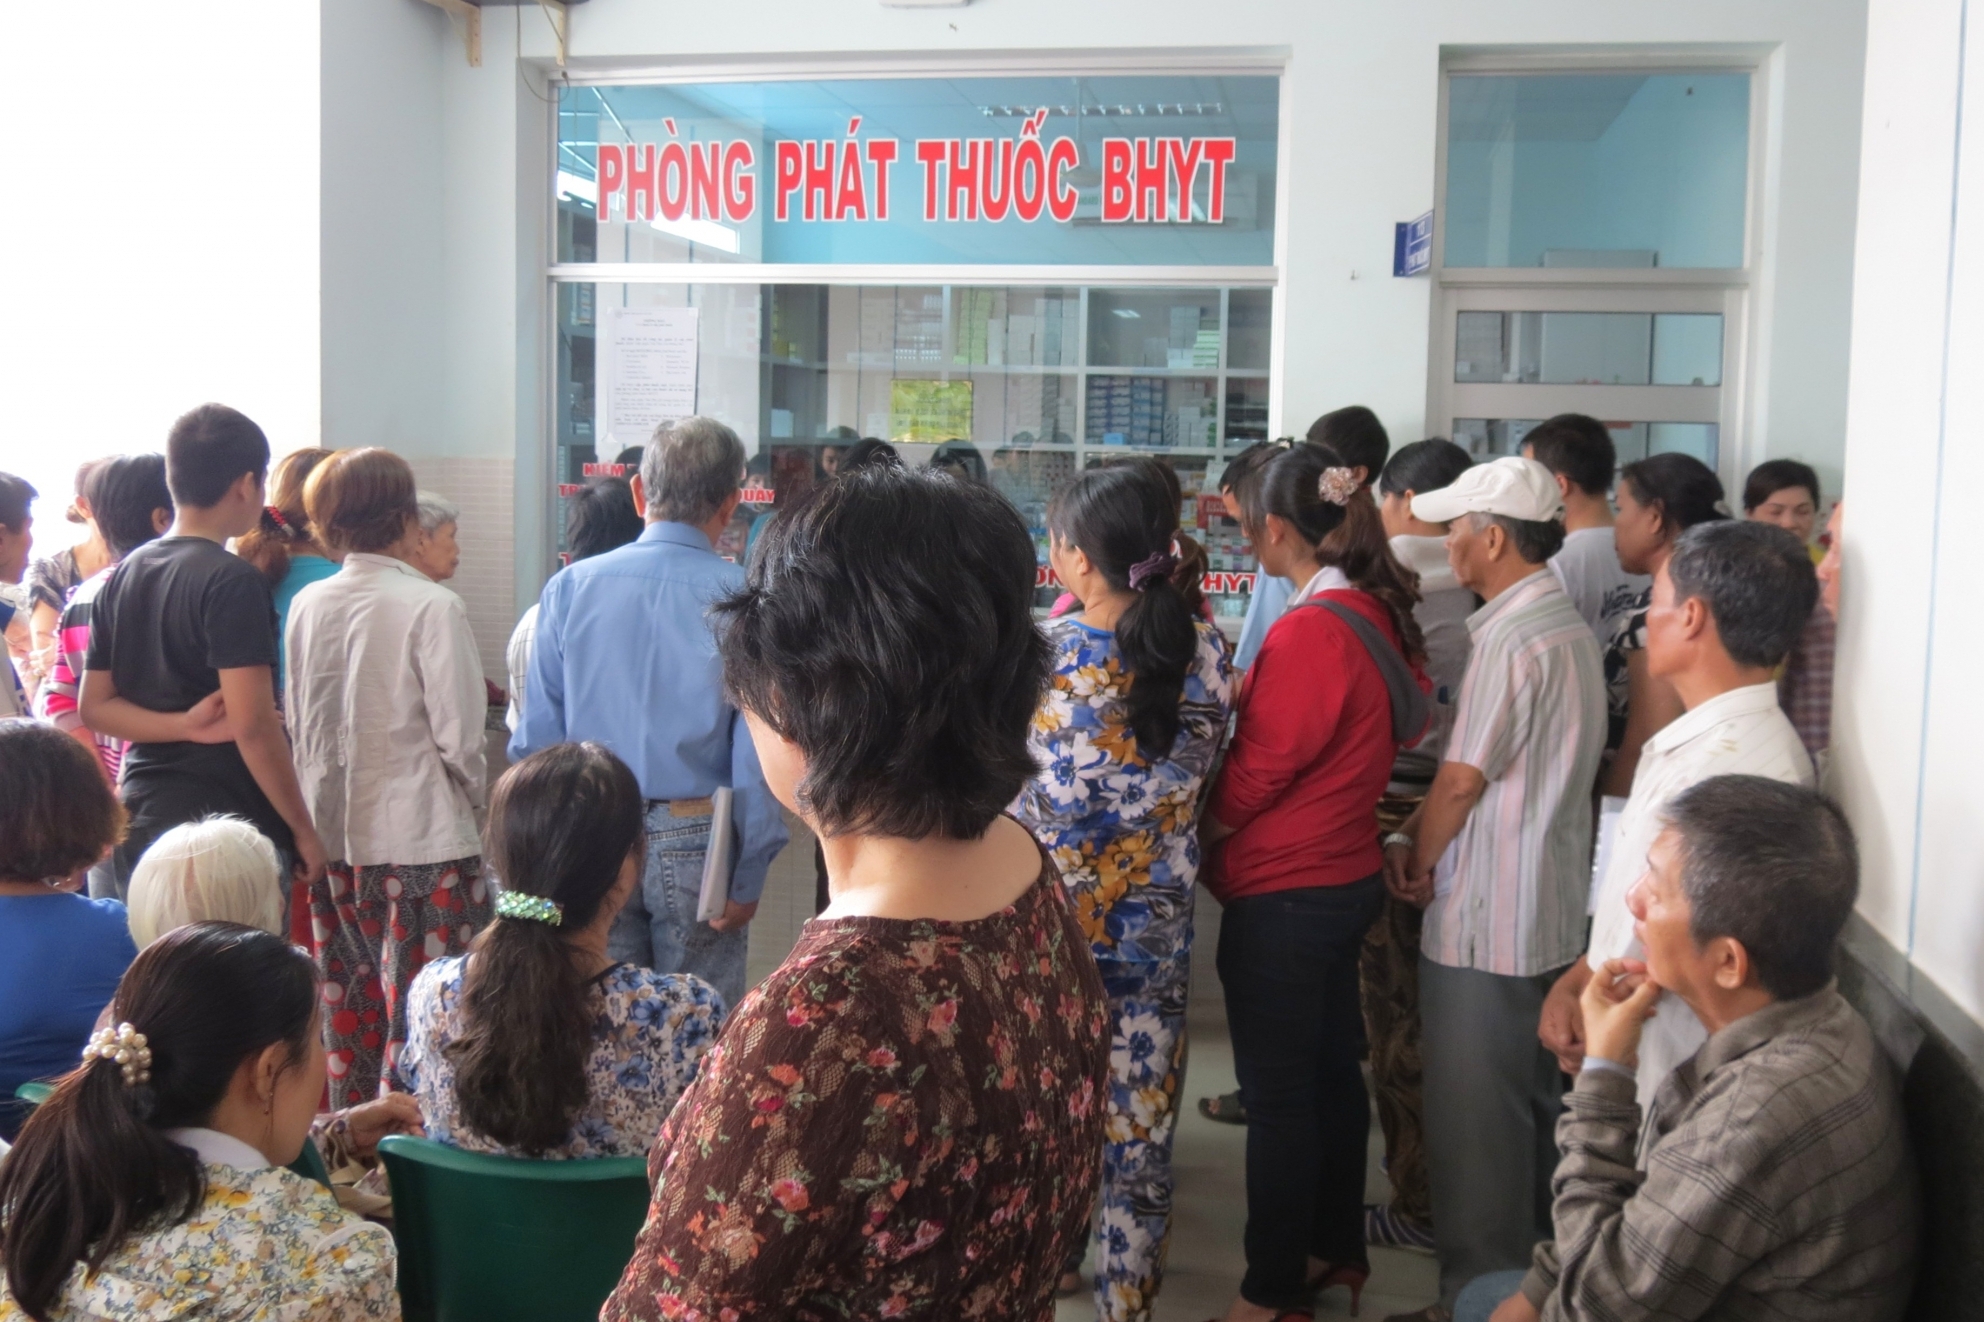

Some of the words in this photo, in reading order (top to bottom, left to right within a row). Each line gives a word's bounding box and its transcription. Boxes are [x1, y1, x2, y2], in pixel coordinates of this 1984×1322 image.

[596, 117, 756, 223] PHÒNG
[774, 116, 899, 222] PHÁT
[915, 108, 1080, 223] THUỐC
[1101, 137, 1236, 223] BHYT
[739, 485, 775, 503] UẦY
[1199, 571, 1257, 594] HYT
